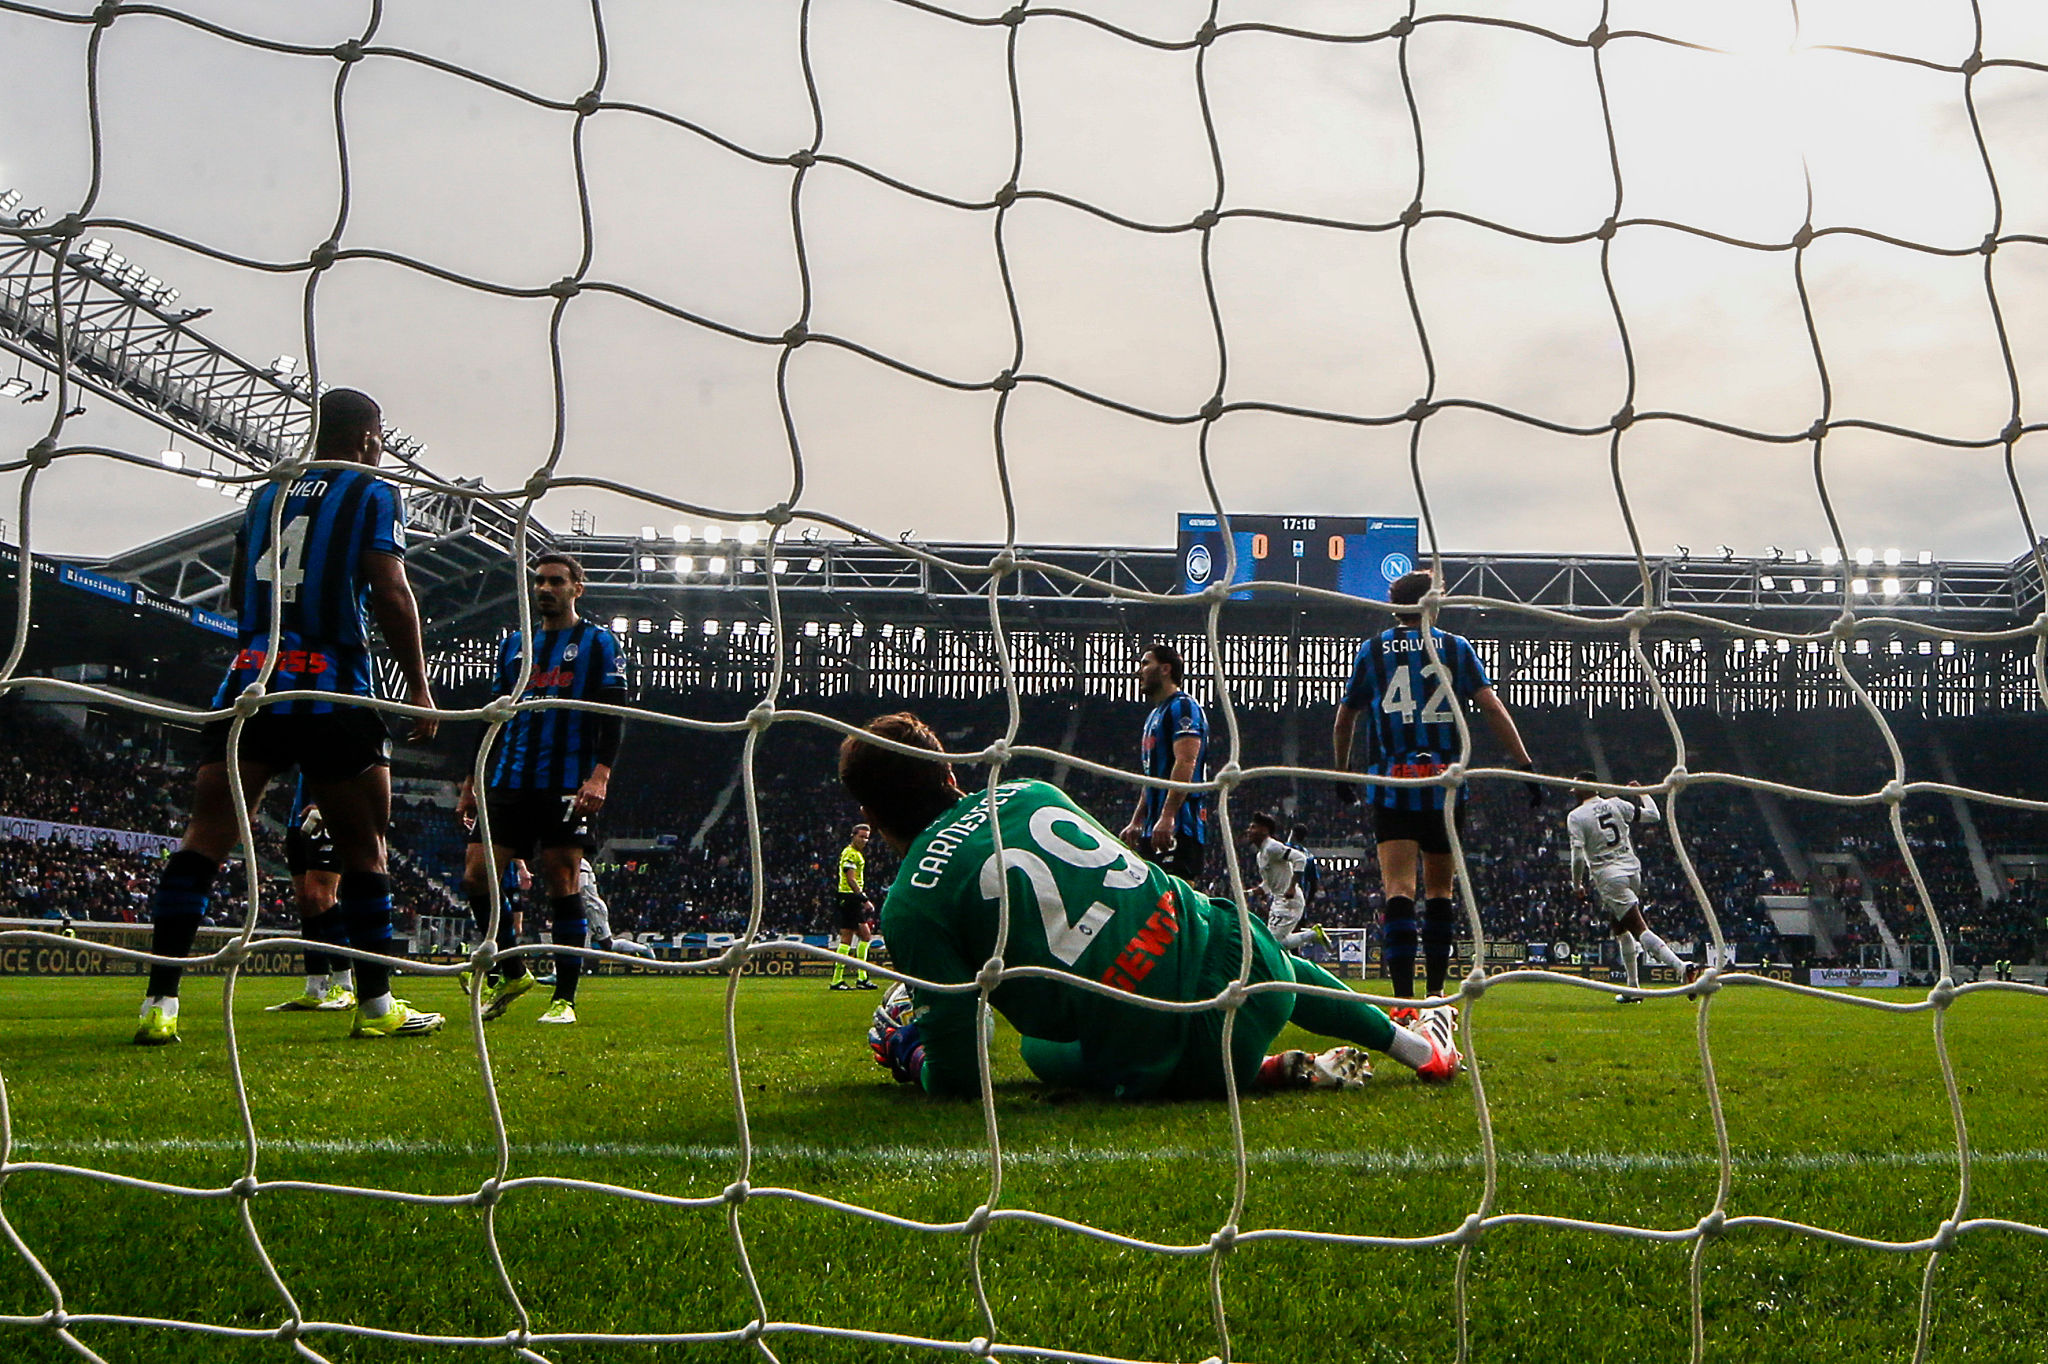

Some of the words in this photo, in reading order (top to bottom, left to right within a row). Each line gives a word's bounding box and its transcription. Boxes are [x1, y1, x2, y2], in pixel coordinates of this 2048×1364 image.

[255, 516, 310, 602] 4
[1252, 534, 1268, 559] 0
[1328, 535, 1345, 560] 0
[67, 569, 127, 598] Rinascimento
[1382, 638, 1443, 655] SCALVNI
[1381, 664, 1455, 724] 42
[2, 821, 39, 841] HOTEL
[1598, 812, 1621, 847] 5
[980, 805, 1149, 967] 29
[37, 948, 103, 973] COLOR
[244, 953, 292, 973] COLOR
[729, 960, 795, 976] OLOR
